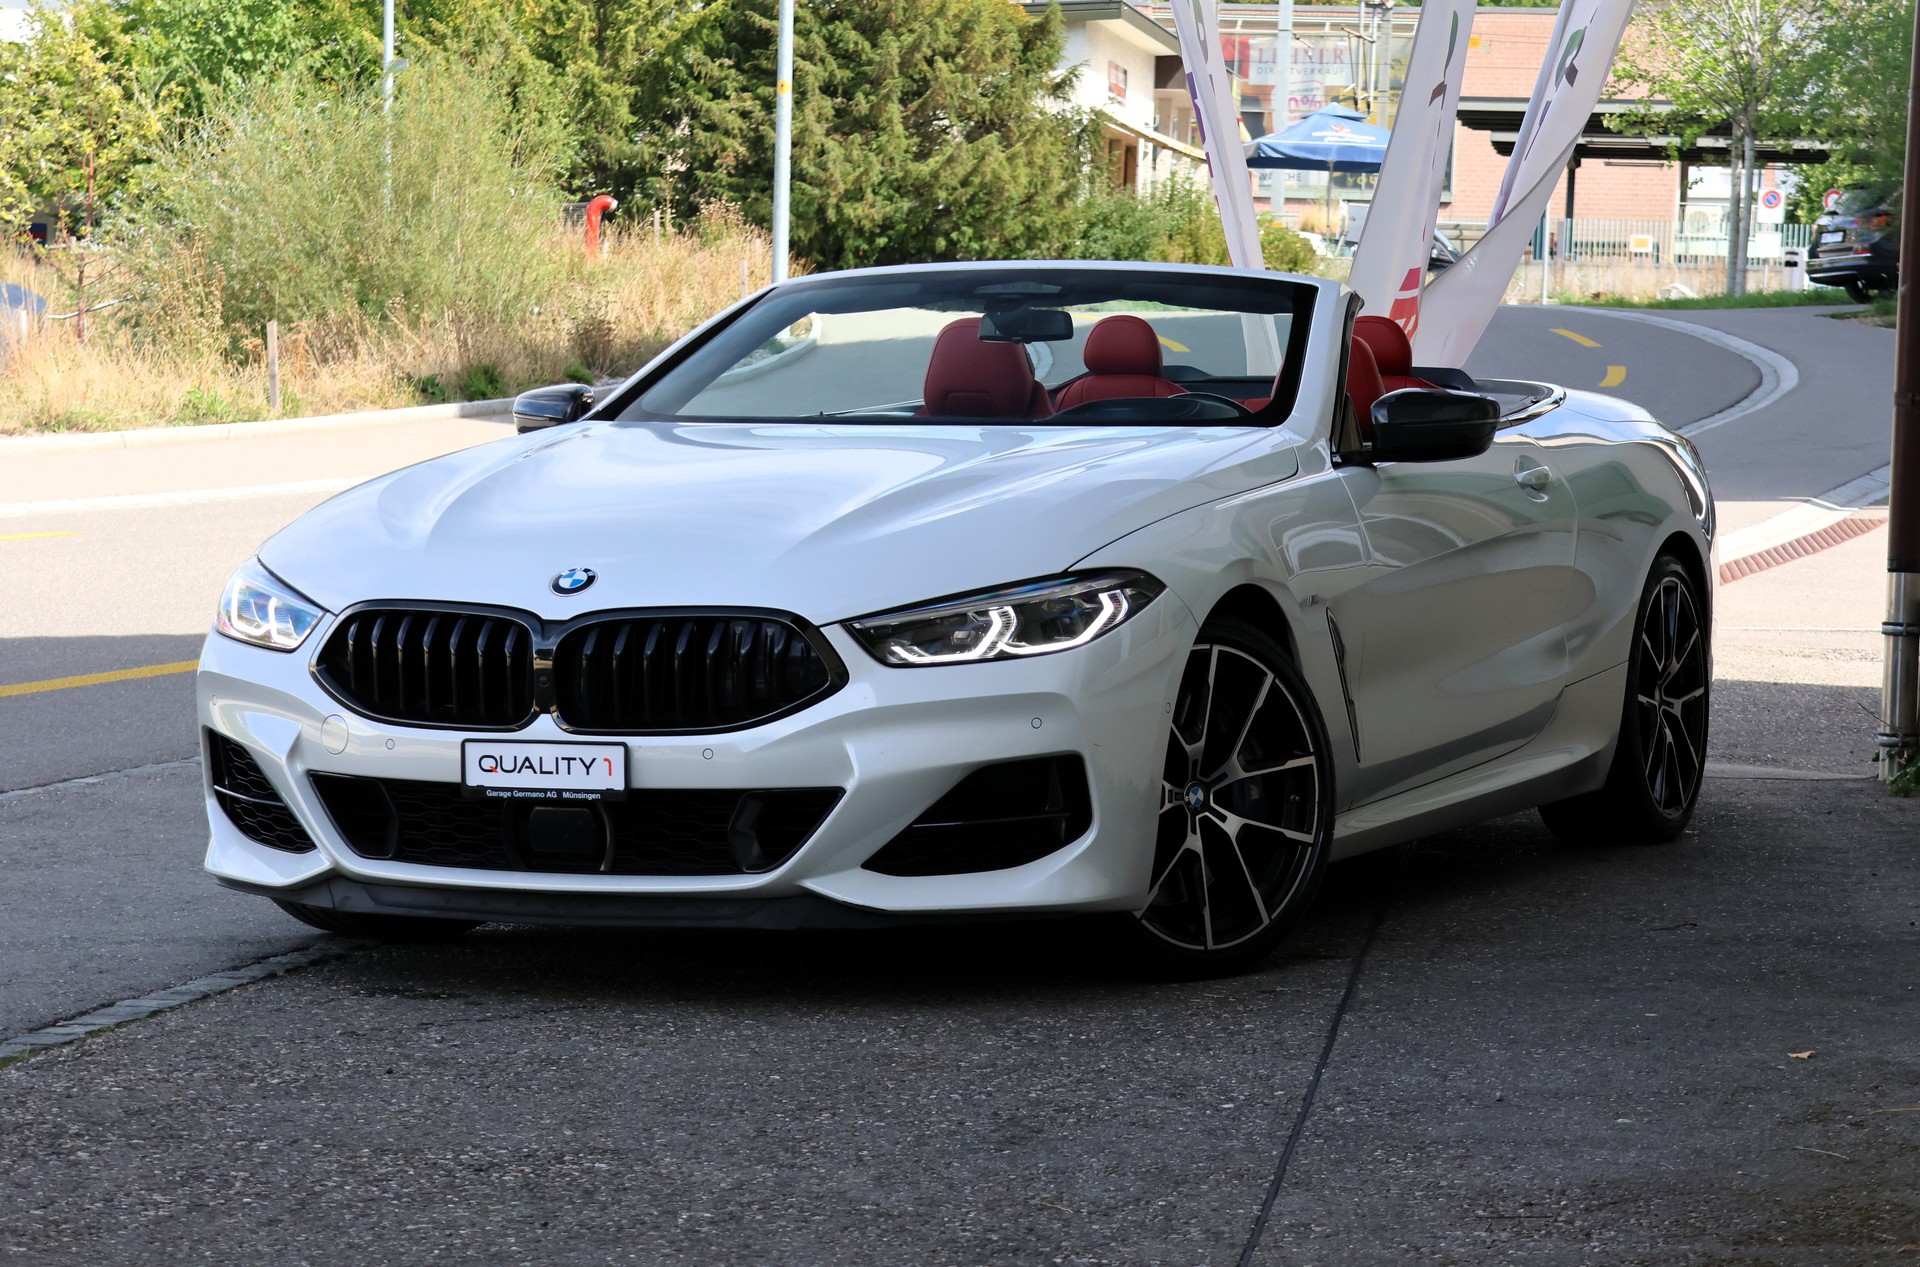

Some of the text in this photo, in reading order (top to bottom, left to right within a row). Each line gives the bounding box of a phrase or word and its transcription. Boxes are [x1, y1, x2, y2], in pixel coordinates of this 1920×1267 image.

[1256, 66, 1345, 76] DIRTVERKAUF
[478, 754, 613, 777] QUALITY 1
[486, 789, 601, 800] Garage Germano AG Münsingen
